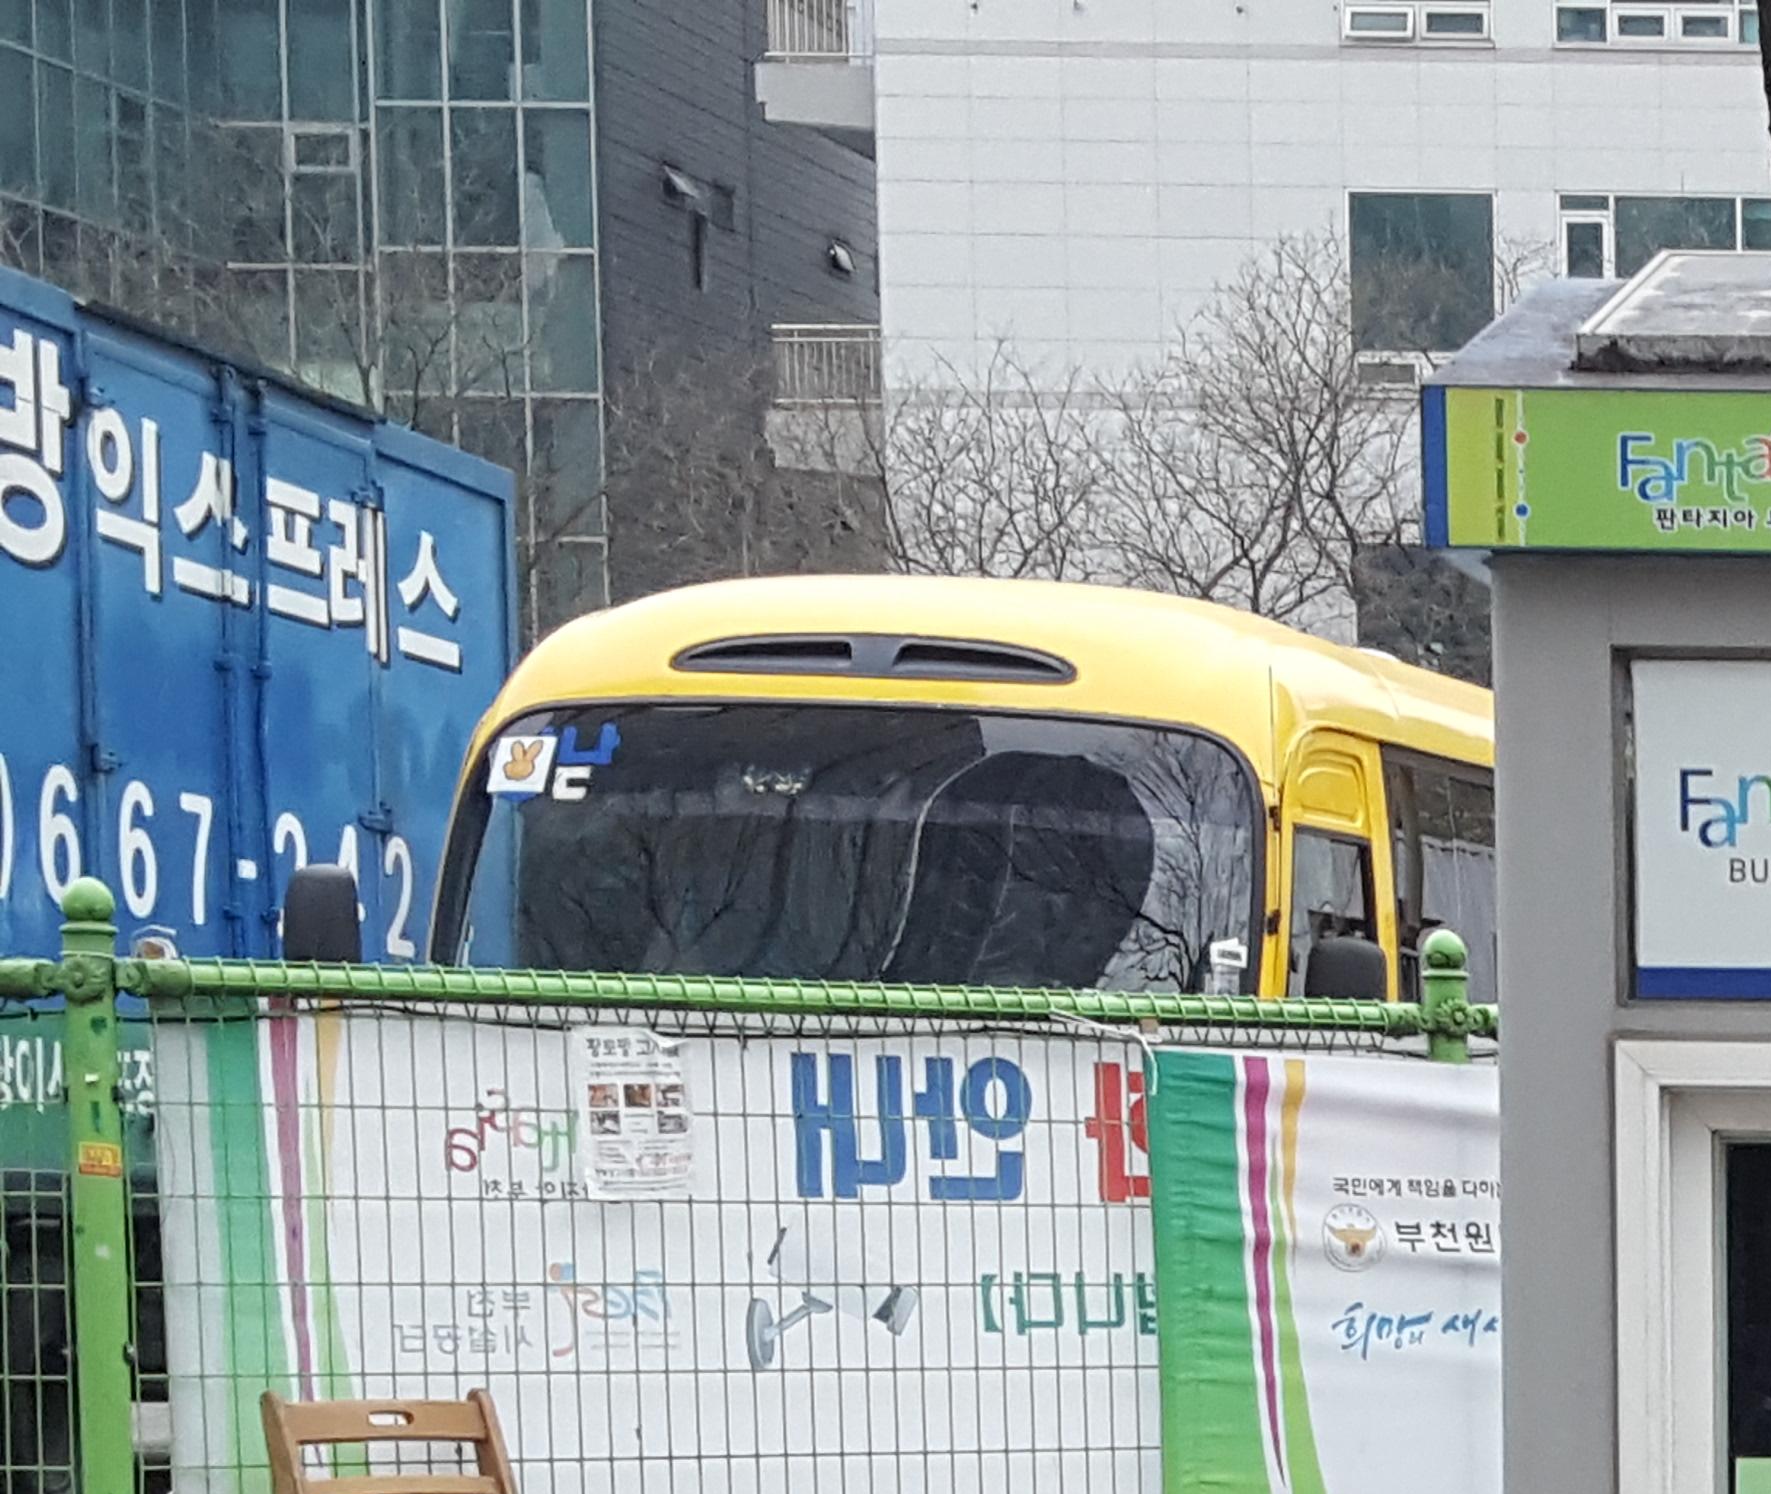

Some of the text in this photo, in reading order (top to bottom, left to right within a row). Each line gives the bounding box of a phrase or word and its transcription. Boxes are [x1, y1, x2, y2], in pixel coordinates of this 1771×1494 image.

[1656, 508, 1755, 530] 판타지아
[1333, 1176, 1402, 1197] 국민에게
[1395, 1220, 1501, 1253] 부천원
